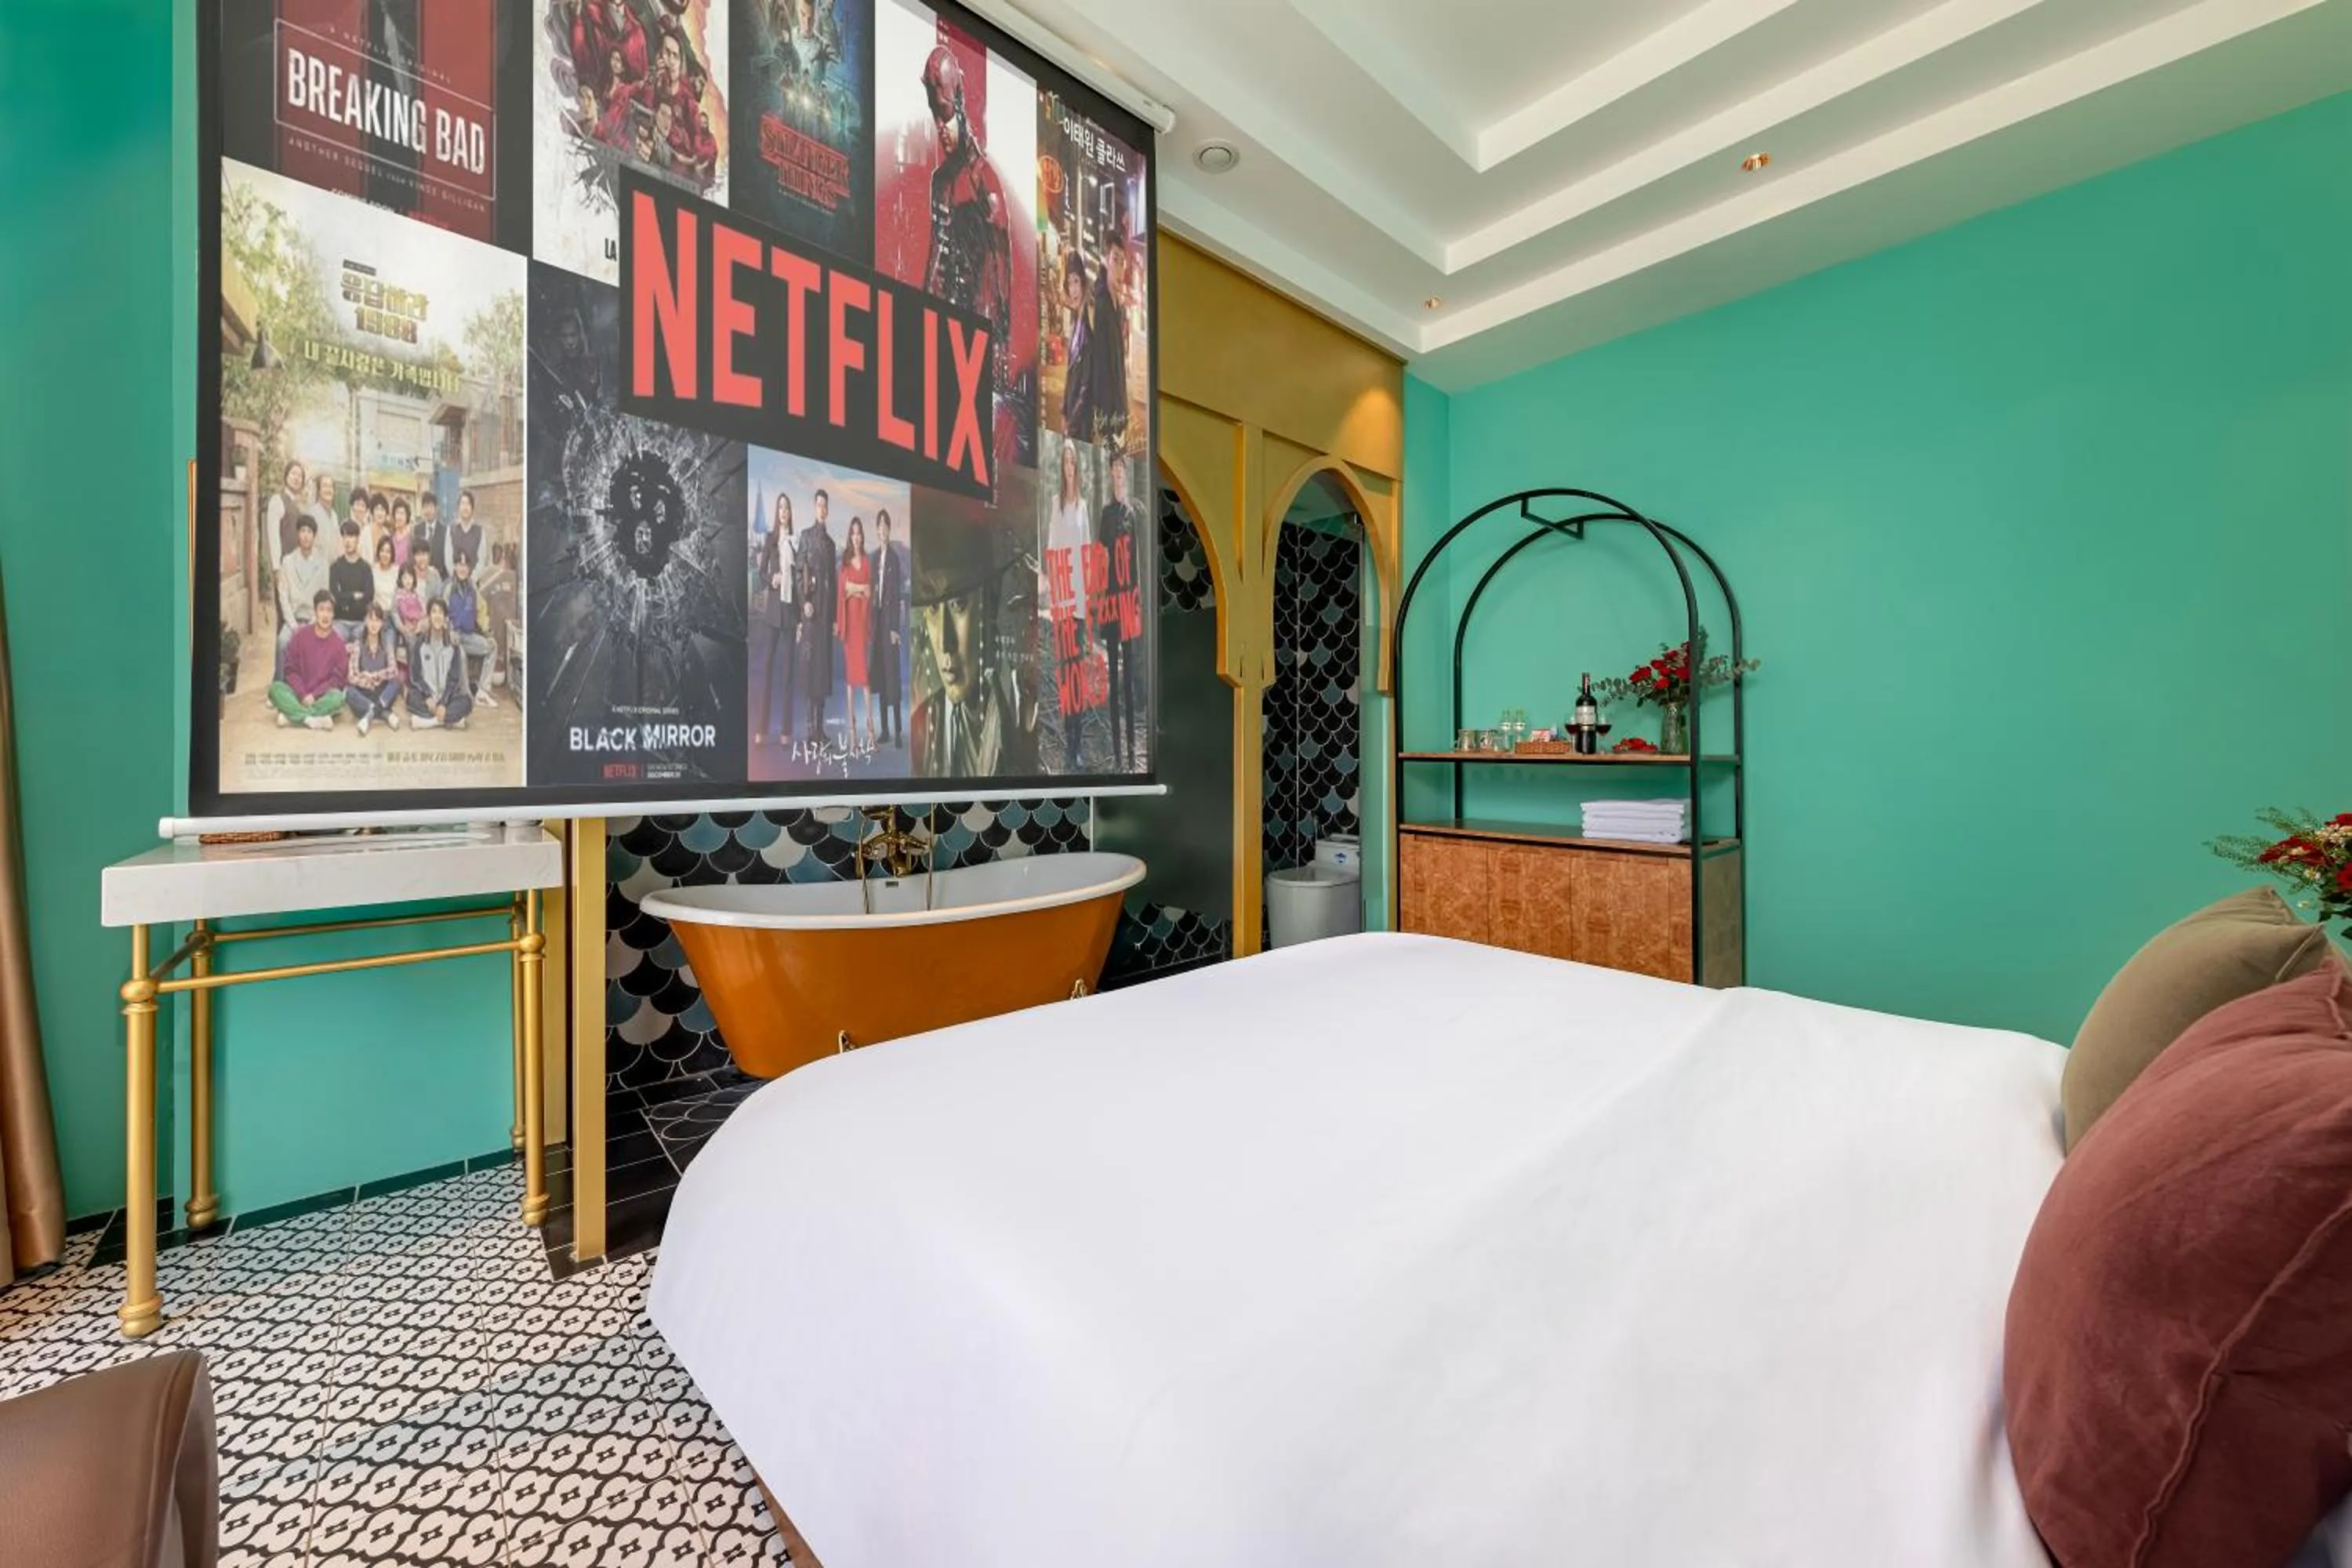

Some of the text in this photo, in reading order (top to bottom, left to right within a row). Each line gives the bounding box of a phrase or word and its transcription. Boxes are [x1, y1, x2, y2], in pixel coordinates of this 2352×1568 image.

[287, 47, 485, 176] BREAKING BAD
[760, 116, 850, 190] STRANGER
[1063, 117, 1094, 158] 이태원
[1096, 137, 1127, 172] 클라쓰
[778, 159, 837, 210] THINGS
[604, 238, 618, 262] LA
[340, 272, 431, 322] 응답하라
[304, 339, 320, 361] 내
[354, 307, 417, 344] 1988
[632, 189, 990, 488] NETFLIX
[1045, 547, 1076, 607] THE
[1114, 534, 1132, 587] OF
[569, 723, 717, 752] BLACK MIRROR
